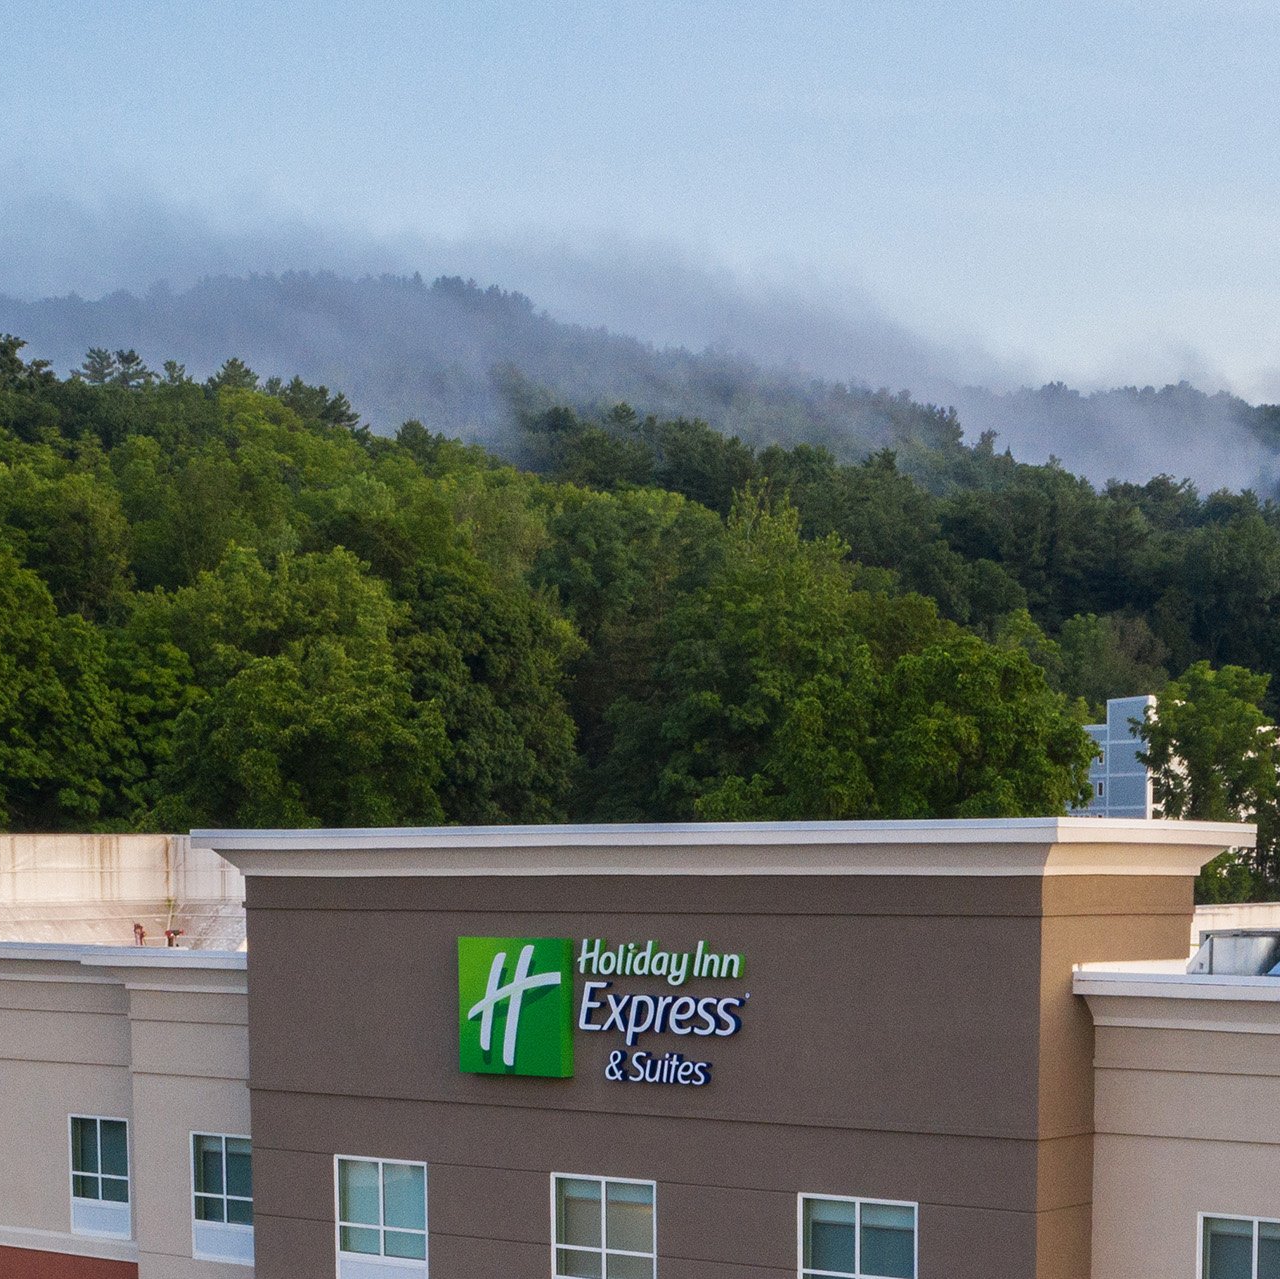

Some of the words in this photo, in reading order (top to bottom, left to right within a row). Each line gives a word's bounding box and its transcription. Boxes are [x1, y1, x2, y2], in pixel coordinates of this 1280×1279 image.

[577, 938, 689, 986] Holiday
[693, 940, 741, 978] Inn
[578, 981, 741, 1046] Express
[604, 1050, 623, 1081] &
[628, 1051, 708, 1086] Suites
